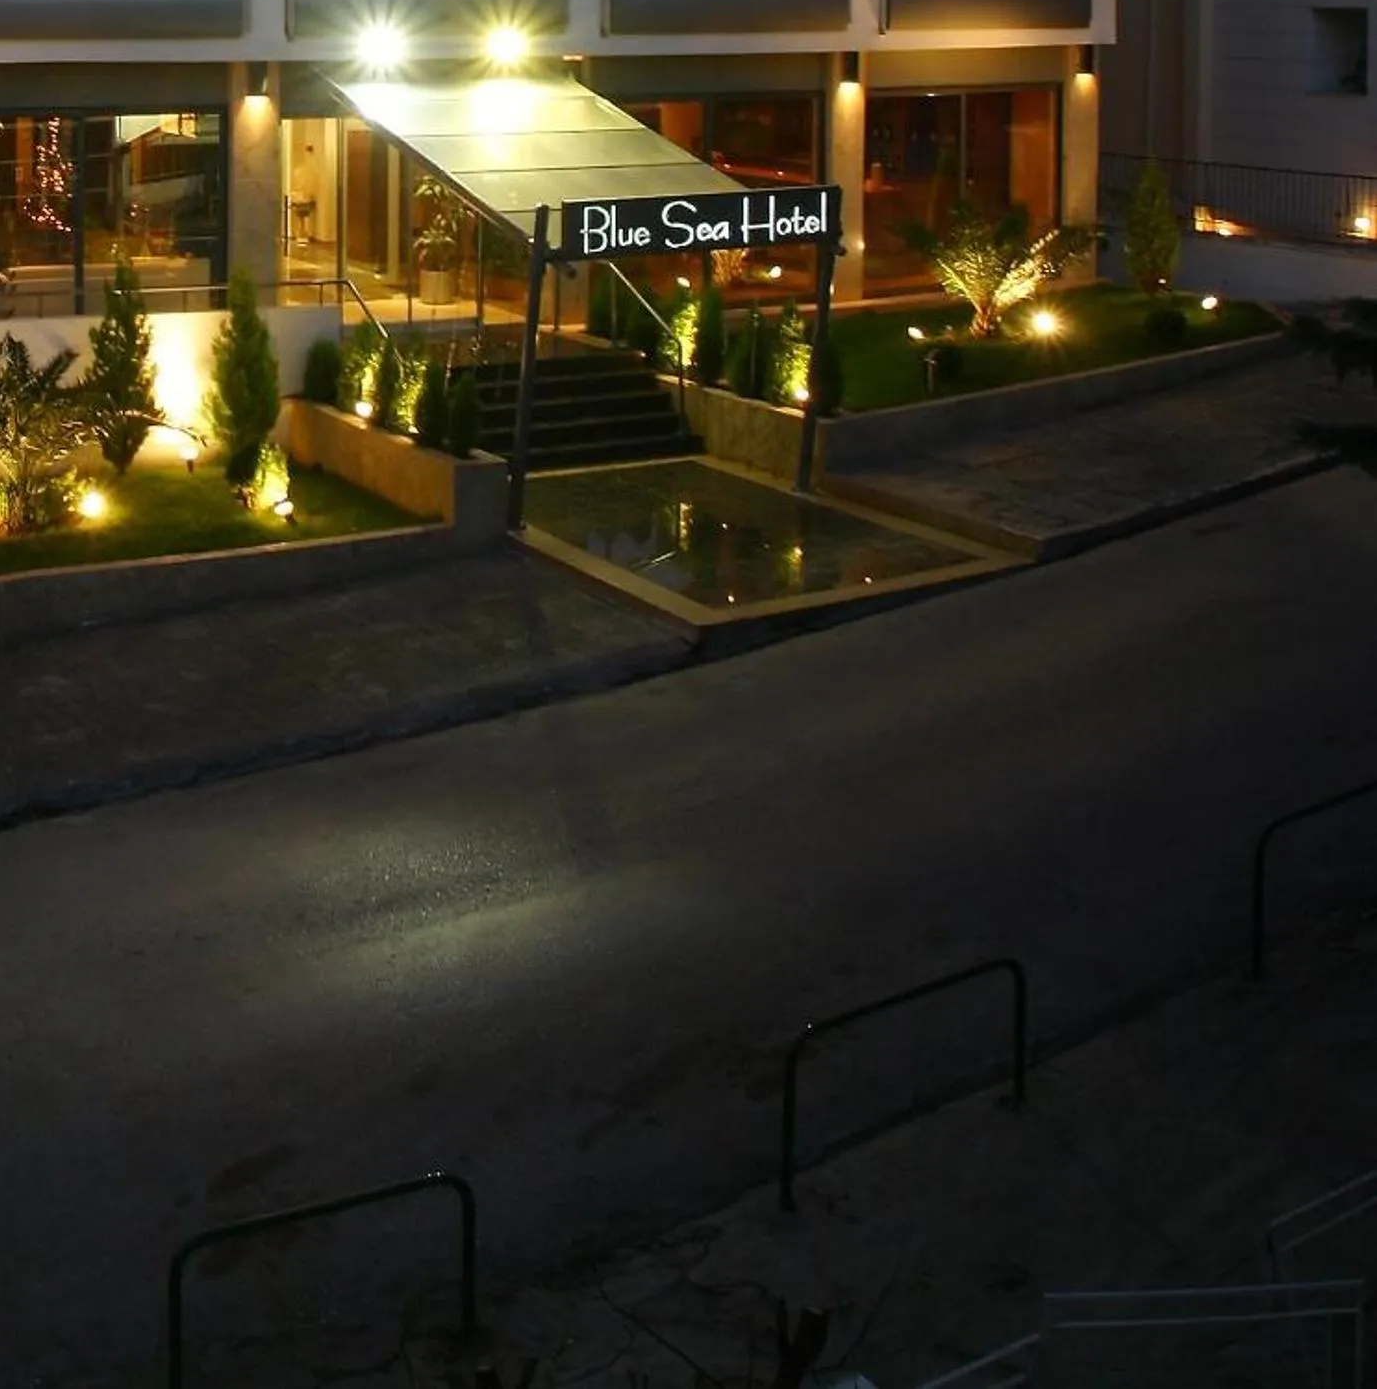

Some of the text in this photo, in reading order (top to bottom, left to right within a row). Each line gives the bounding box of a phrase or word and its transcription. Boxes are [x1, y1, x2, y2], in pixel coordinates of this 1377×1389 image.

[579, 191, 828, 255] Blue Sea Hotel
